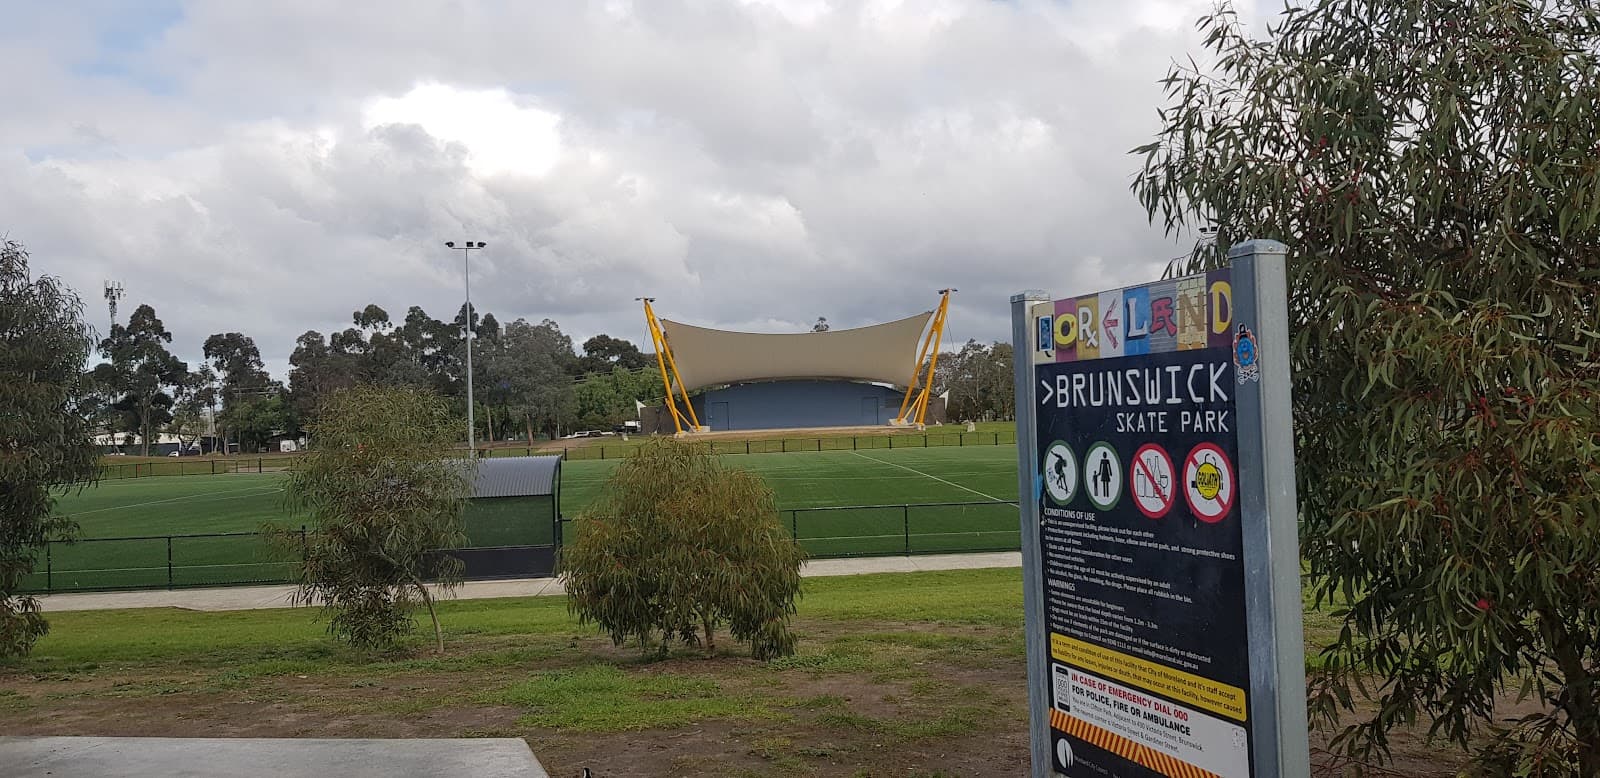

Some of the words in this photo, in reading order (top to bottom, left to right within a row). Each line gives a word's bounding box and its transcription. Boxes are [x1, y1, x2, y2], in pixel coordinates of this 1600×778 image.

[1116, 411, 1168, 432] SKATE
[1181, 410, 1229, 432] PARK
[1044, 507, 1075, 518] CONDITIONS
[1076, 511, 1083, 519] OF
[1084, 512, 1095, 521] USE
[1047, 578, 1075, 591] WARNINGS
[1071, 673, 1078, 682] IN
[1079, 676, 1096, 688] CASE
[1097, 682, 1106, 692] OF
[1108, 686, 1151, 709] EMERGENCY
[1154, 702, 1171, 716] DIAL
[1173, 709, 1188, 722] 000
[1072, 684, 1084, 696] FOR
[1086, 690, 1111, 708] POLICE,
[1113, 700, 1128, 713] FIRE
[1130, 706, 1140, 718] OR
[1142, 710, 1190, 737] AMBULANCE
